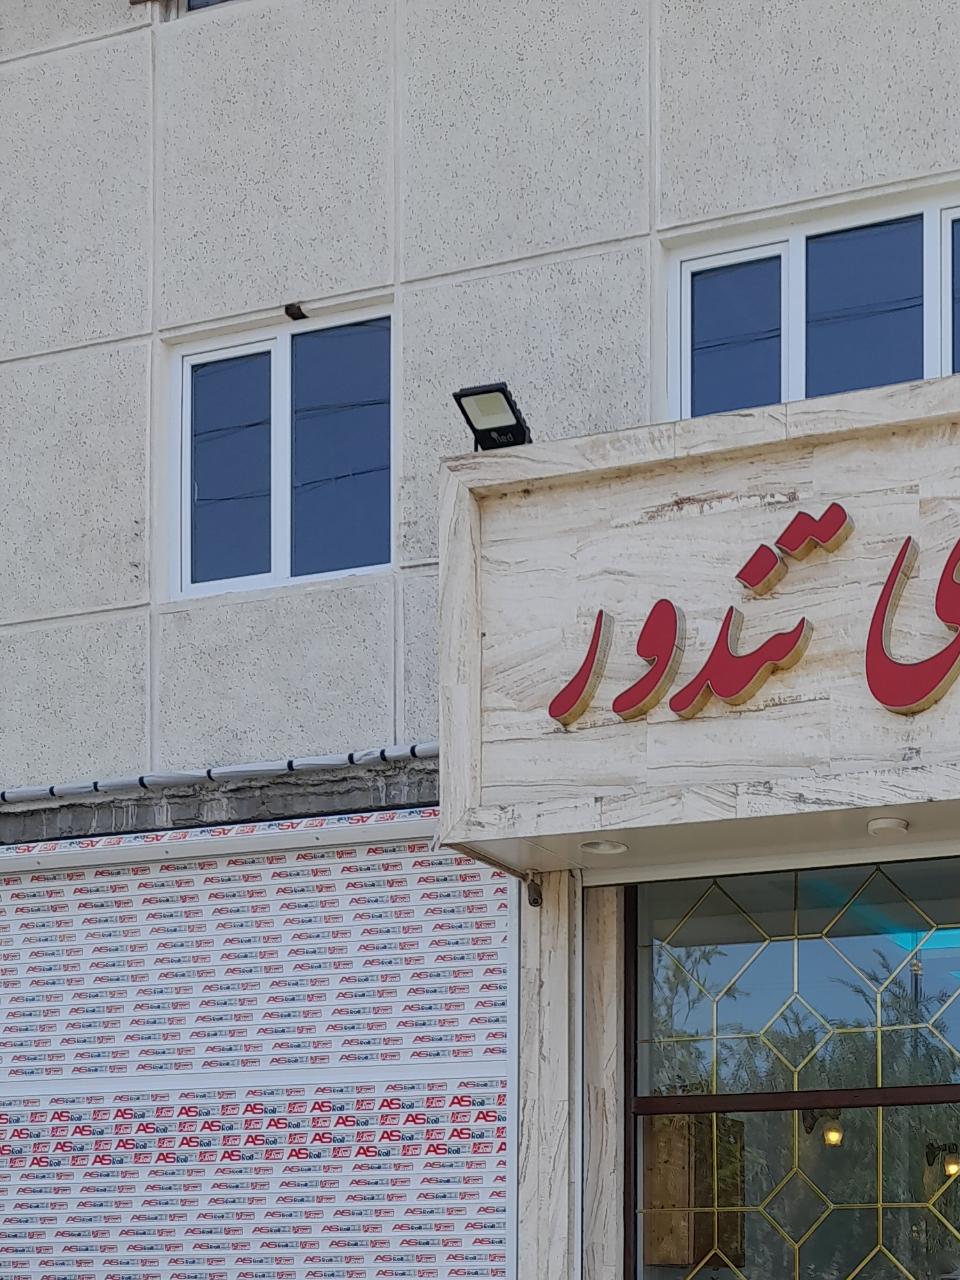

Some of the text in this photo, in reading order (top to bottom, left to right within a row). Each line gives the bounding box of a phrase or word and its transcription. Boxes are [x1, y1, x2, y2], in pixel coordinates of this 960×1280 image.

[548, 502, 856, 725] تندور
[366, 847, 384, 855] AS
[203, 876, 220, 884] AS
[288, 948, 305, 956] AS
[29, 979, 45, 987] AS
[338, 976, 357, 984] AS
[402, 1004, 421, 1012] AS
[255, 1027, 274, 1035] AS
[412, 1036, 431, 1044] AS
[201, 1060, 218, 1068] AS
[385, 1083, 403, 1091] AS
[378, 1098, 400, 1110] AS
[401, 1102, 414, 1110] Roll
[449, 1095, 471, 1107] AS
[177, 1106, 199, 1117] AS
[199, 1109, 211, 1117] Roll
[242, 1103, 264, 1115] AS
[310, 1101, 331, 1113] AS
[50, 1111, 70, 1122] AS
[70, 1114, 82, 1122] Roll
[113, 1108, 133, 1120] AS
[404, 1114, 426, 1125] AS
[474, 1111, 496, 1122] AS
[200, 1120, 221, 1132] AS
[221, 1124, 233, 1132] Roll
[266, 1118, 287, 1130] AS
[334, 1115, 355, 1127] AS
[10, 1128, 30, 1139] AS
[30, 1131, 41, 1139] Roll
[72, 1125, 92, 1136] AS
[92, 1128, 104, 1136] Roll
[135, 1122, 155, 1134] AS
[311, 1132, 332, 1144] AS
[332, 1136, 345, 1144] Roll
[379, 1130, 400, 1142] AS
[448, 1128, 470, 1140] AS
[115, 1138, 135, 1150] AS
[179, 1136, 199, 1148] AS
[244, 1134, 264, 1146] AS
[265, 1138, 277, 1146] Roll
[53, 1141, 73, 1152] AS
[73, 1144, 84, 1152] Roll
[355, 1146, 377, 1158] AS
[425, 1144, 447, 1155] AS
[155, 1152, 176, 1164] AS
[220, 1150, 241, 1162] AS
[287, 1148, 308, 1160] AS
[29, 1156, 49, 1168] AS
[92, 1154, 111, 1166] AS
[19, 1172, 35, 1180] AS
[348, 1179, 367, 1187] AS
[404, 1207, 422, 1215] AS
[234, 1257, 252, 1265] AS
[448, 1268, 466, 1276] AS
